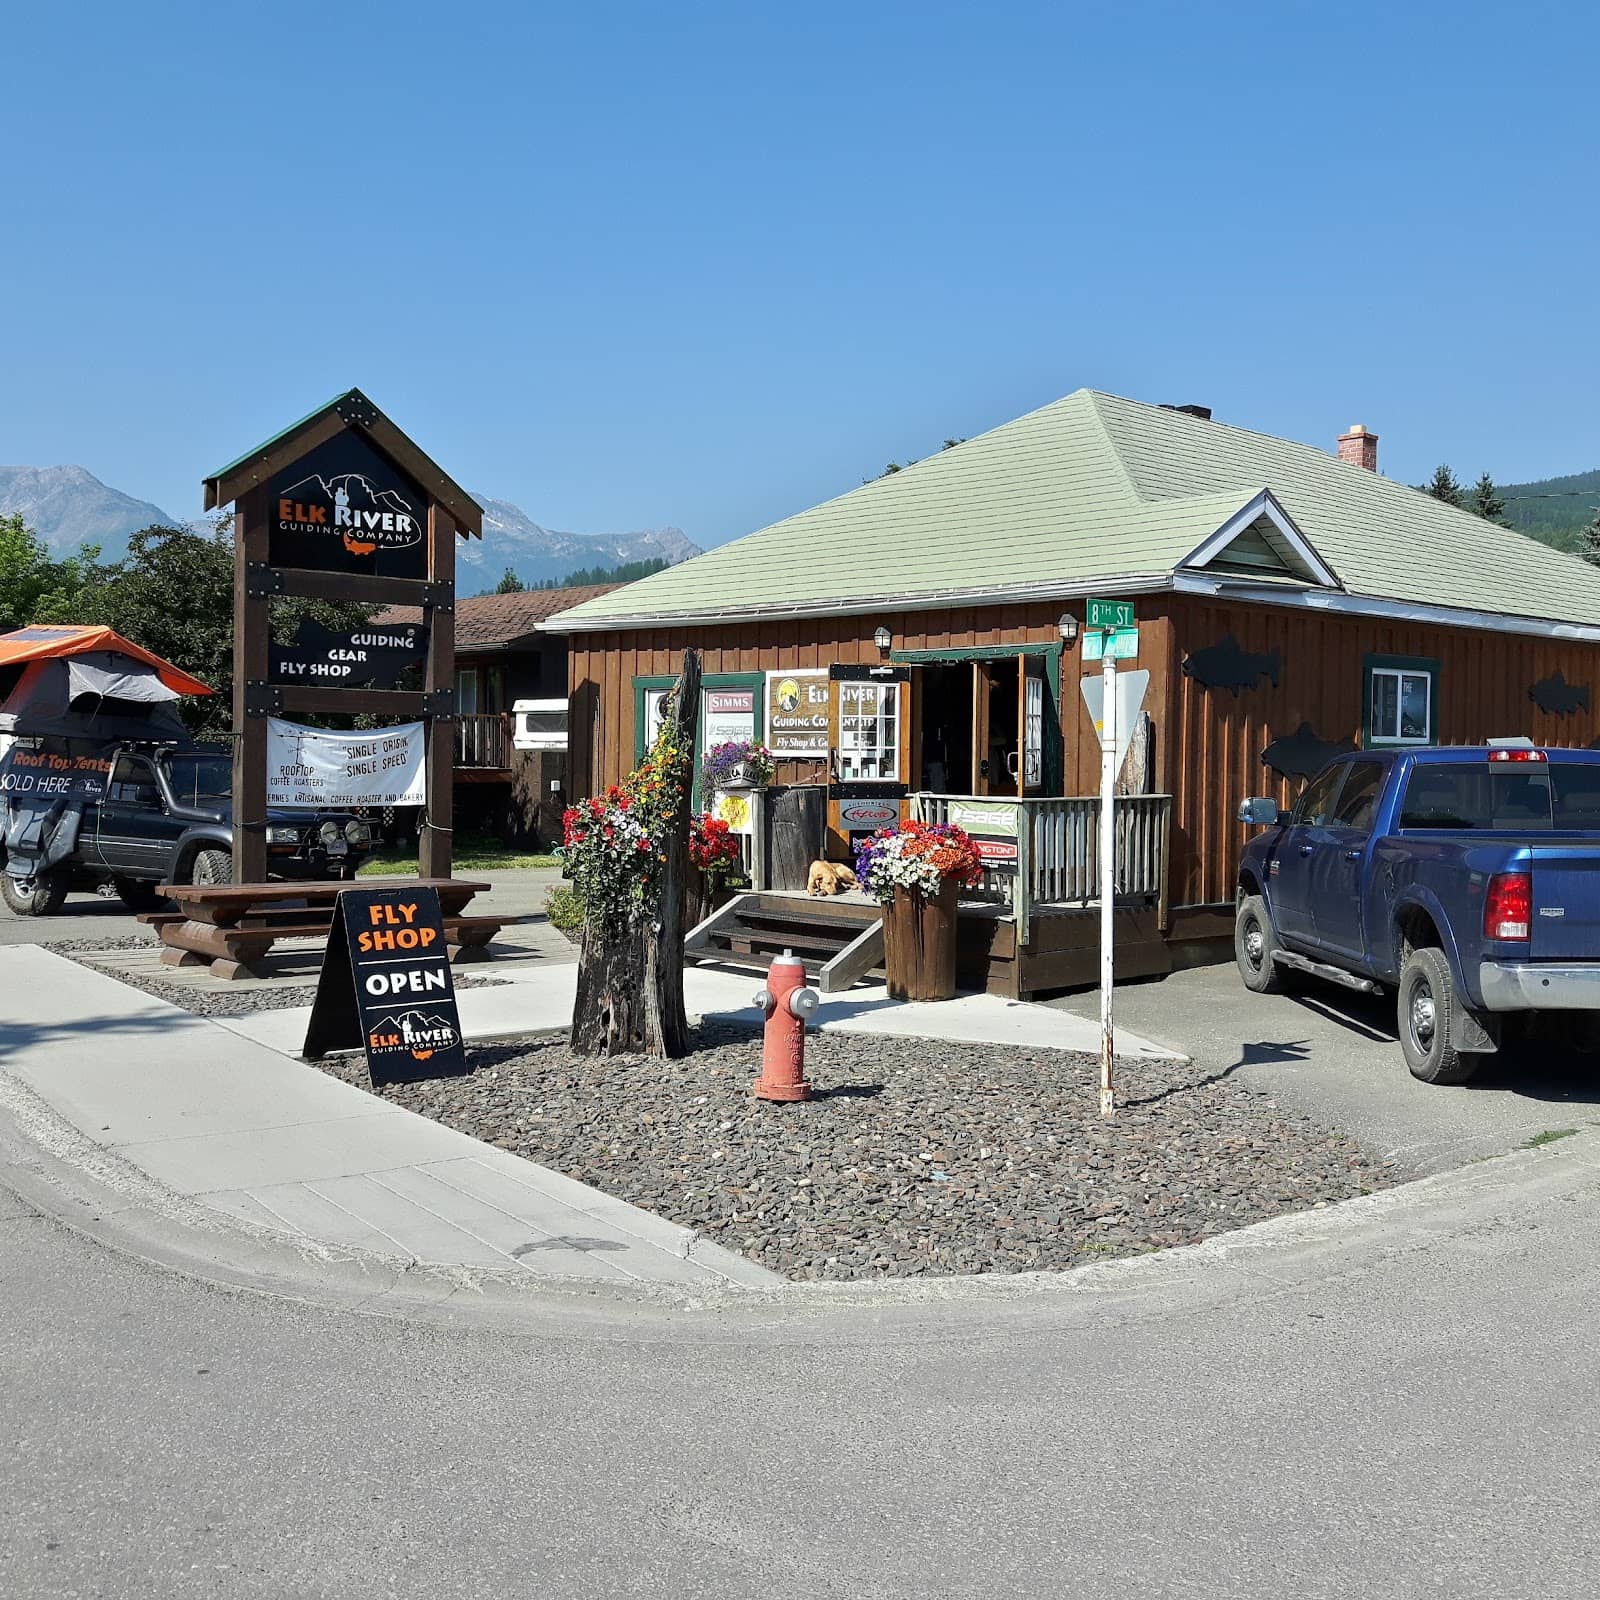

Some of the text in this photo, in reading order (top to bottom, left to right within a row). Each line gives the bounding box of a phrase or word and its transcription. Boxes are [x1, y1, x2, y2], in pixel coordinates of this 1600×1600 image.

[279, 499, 412, 533] ELK RIVER
[279, 520, 413, 543] GUIDING COMPANY
[1091, 603, 1129, 625] 8TH ST
[350, 633, 414, 649] GUIDING
[328, 649, 367, 662] GEAR
[280, 661, 351, 677] FLY SHOP
[712, 696, 749, 708] SIMMS
[773, 715, 809, 727] GUIDING
[776, 737, 789, 749] Fly
[789, 737, 808, 749] Shop
[809, 736, 816, 747] &
[13, 752, 112, 772] Roof Top Tents
[346, 760, 377, 777] SINGLE
[280, 765, 315, 778] ROOFTOP
[0, 773, 73, 794] SOLD HERE
[270, 777, 324, 787] COFFEE ROASTERS
[331, 794, 353, 804] COFFEE
[385, 793, 397, 802] AND
[369, 903, 418, 926] FLY
[358, 928, 436, 952] SHOP
[365, 969, 446, 996] OPEN
[369, 1028, 453, 1047] ELK RIVER
[371, 1040, 454, 1054] GUIDING COMPANY
